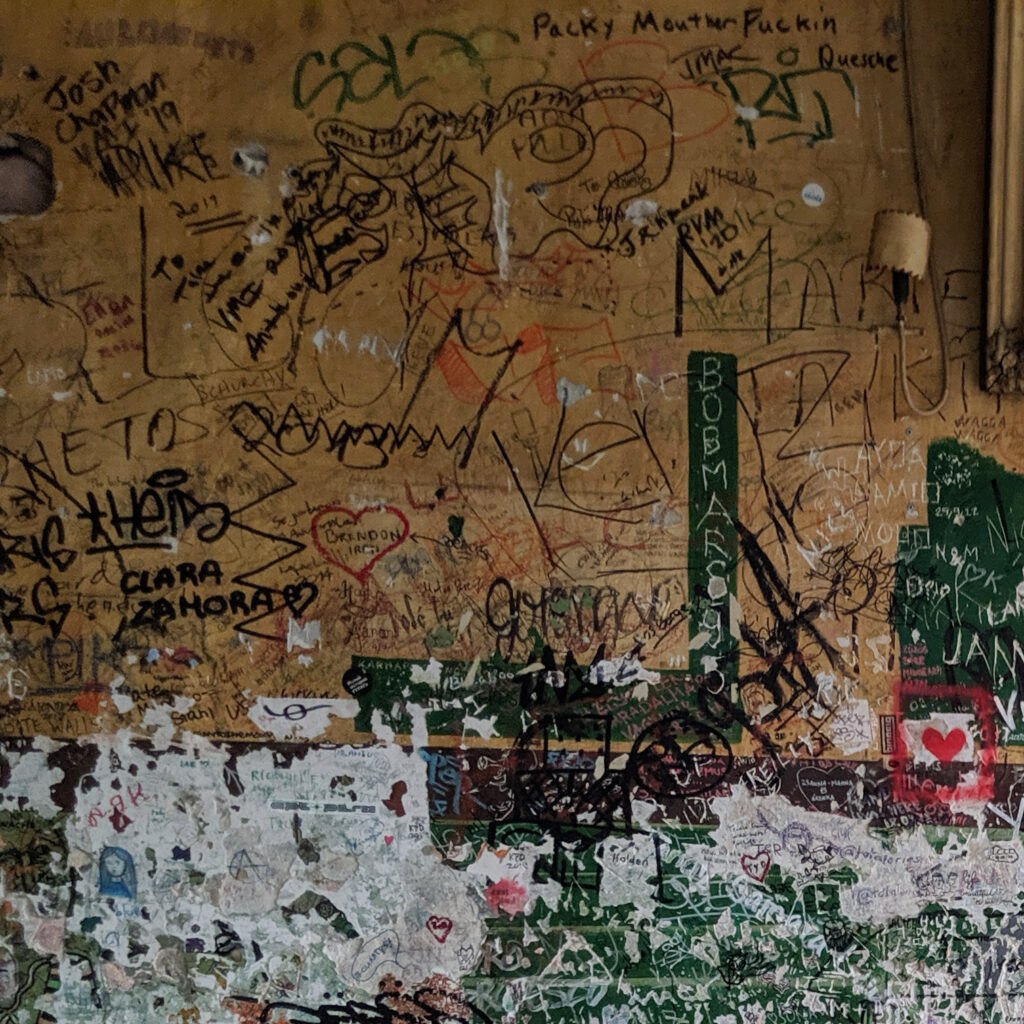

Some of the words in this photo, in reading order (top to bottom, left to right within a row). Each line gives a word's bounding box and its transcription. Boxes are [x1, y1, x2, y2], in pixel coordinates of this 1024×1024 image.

[532, 12, 614, 40] Packy
[742, 6, 838, 38] Fuckin
[325, 528, 401, 544] BRENDON
[120, 559, 223, 595] CLARA
